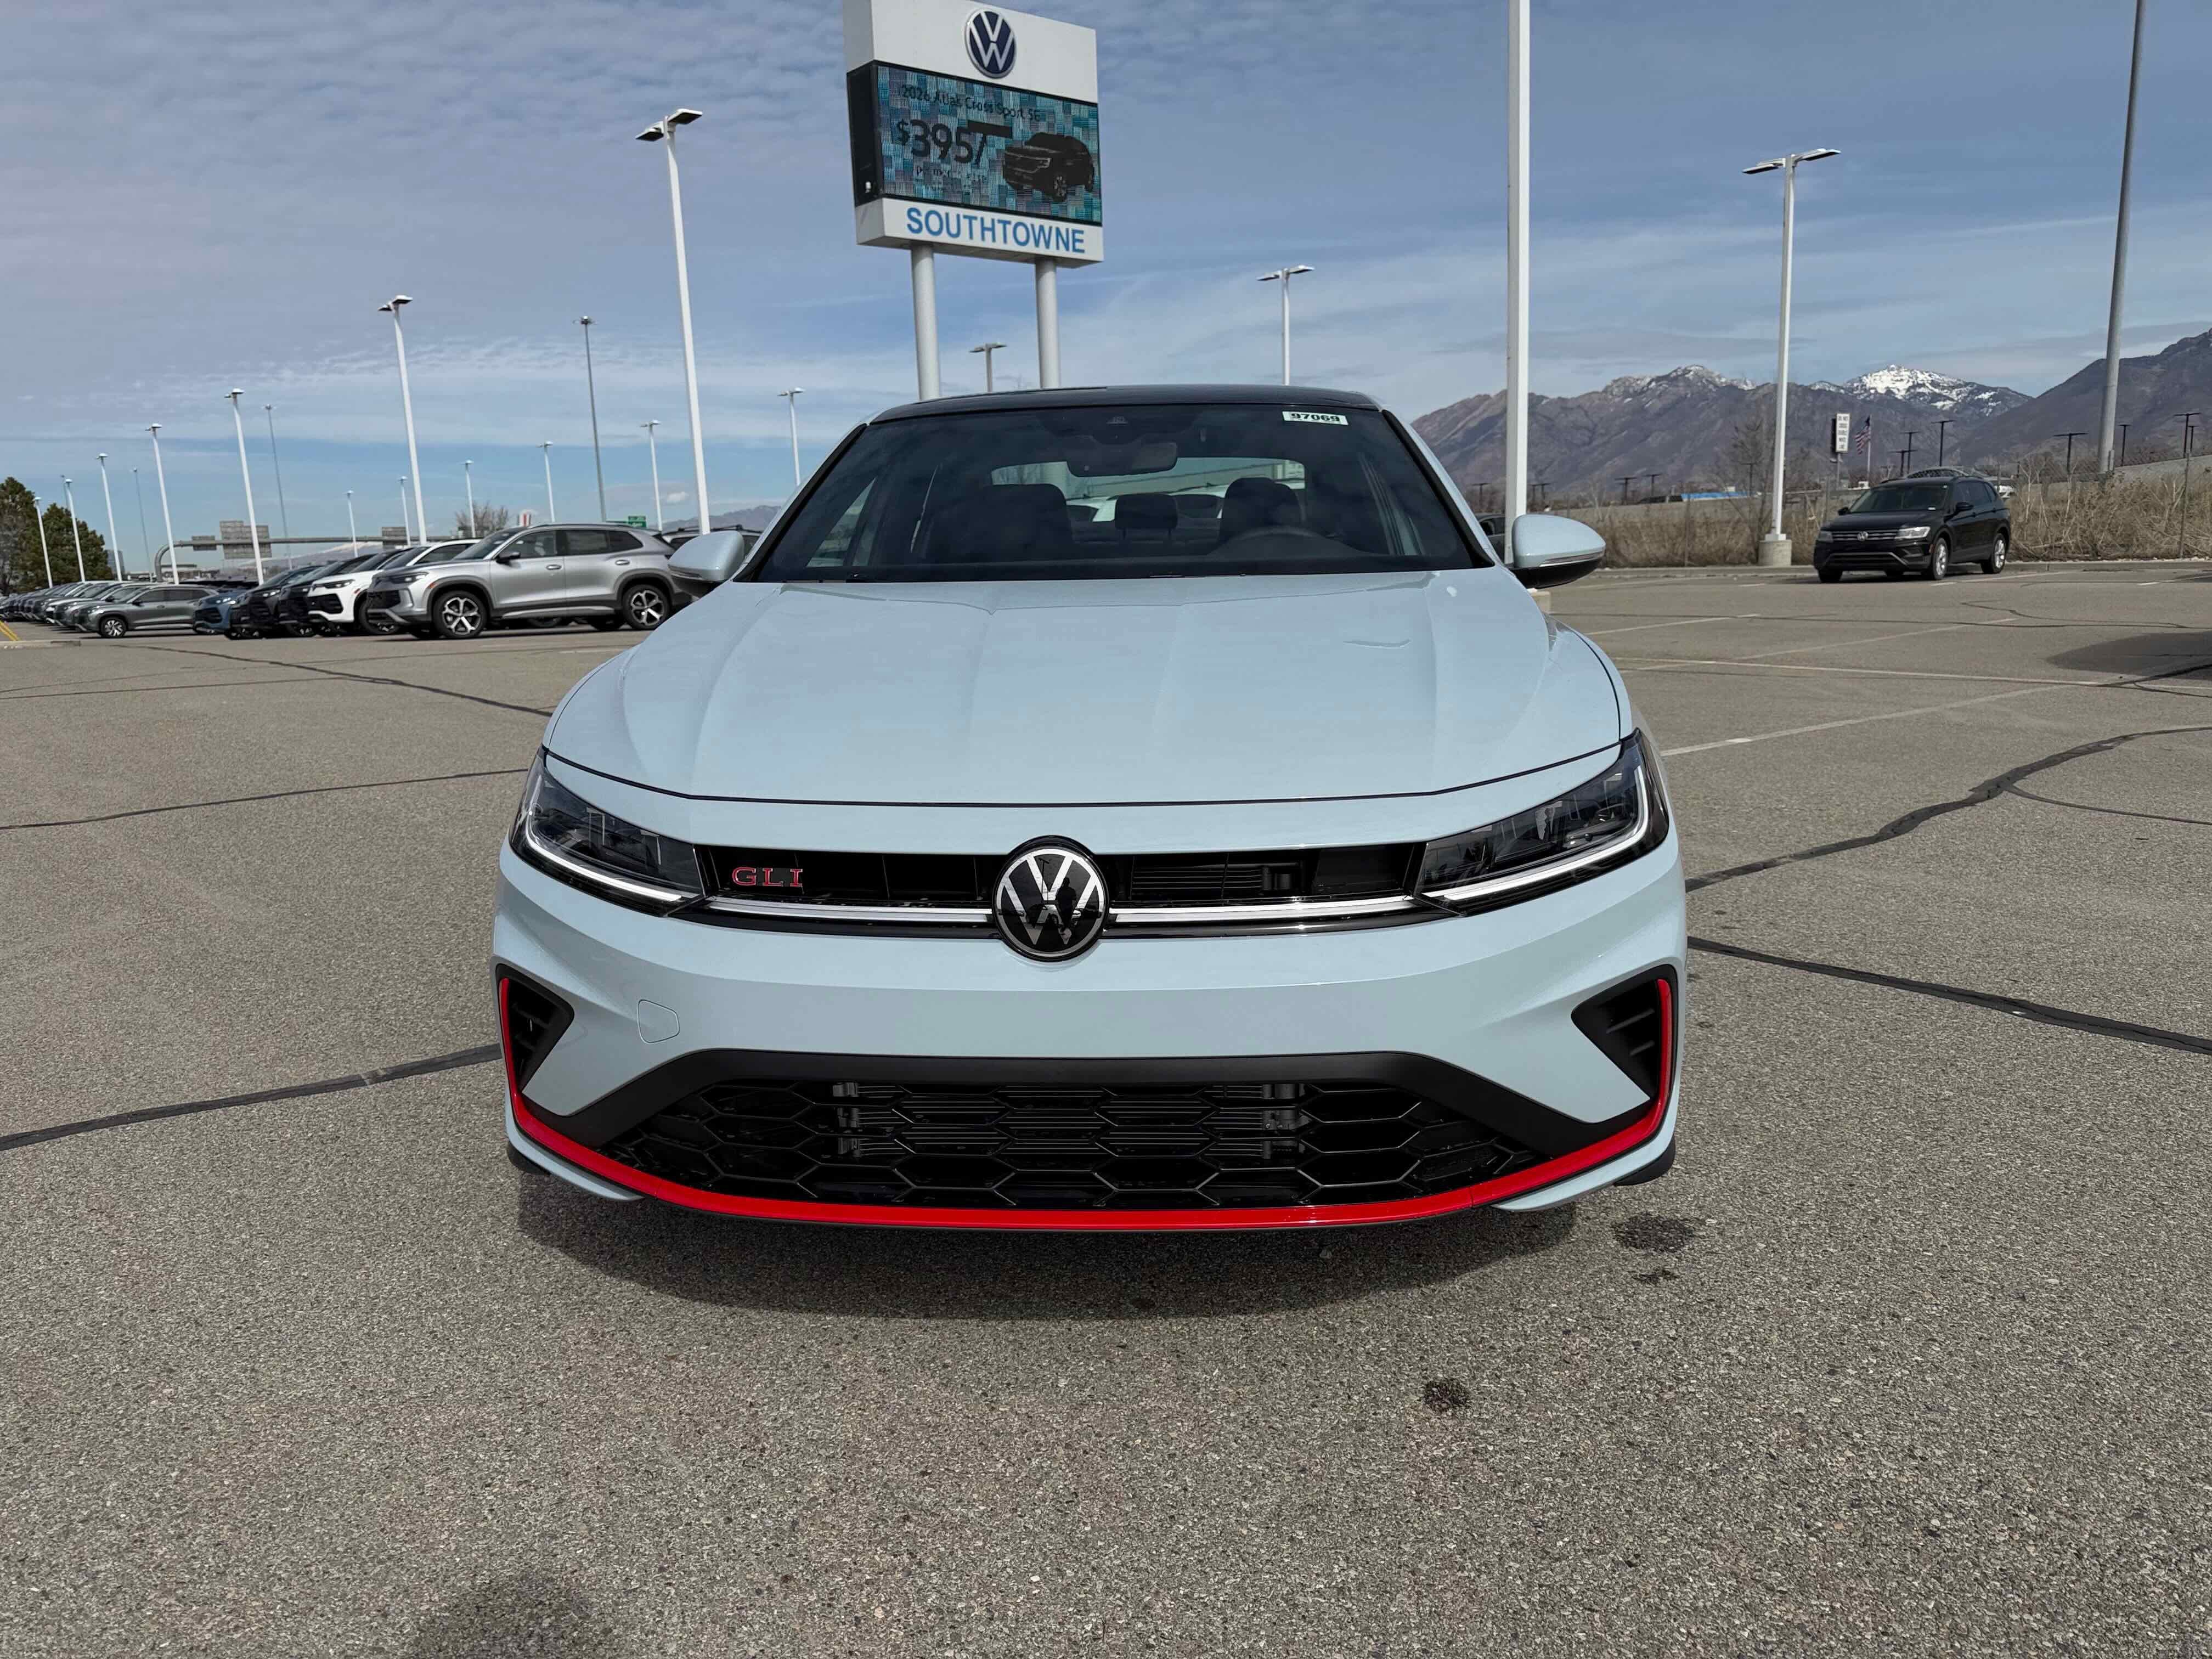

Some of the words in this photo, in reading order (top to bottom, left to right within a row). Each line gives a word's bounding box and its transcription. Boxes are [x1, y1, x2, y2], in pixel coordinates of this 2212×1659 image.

[964, 8, 1017, 78] VW
[933, 89, 962, 108] Atlas
[965, 97, 994, 114] Cross
[996, 102, 1025, 119] Sport
[906, 207, 1085, 253] SOUTHTOWNE
[1291, 413, 1340, 421] 97069
[732, 866, 803, 887] GLI
[996, 848, 1104, 957] VW
